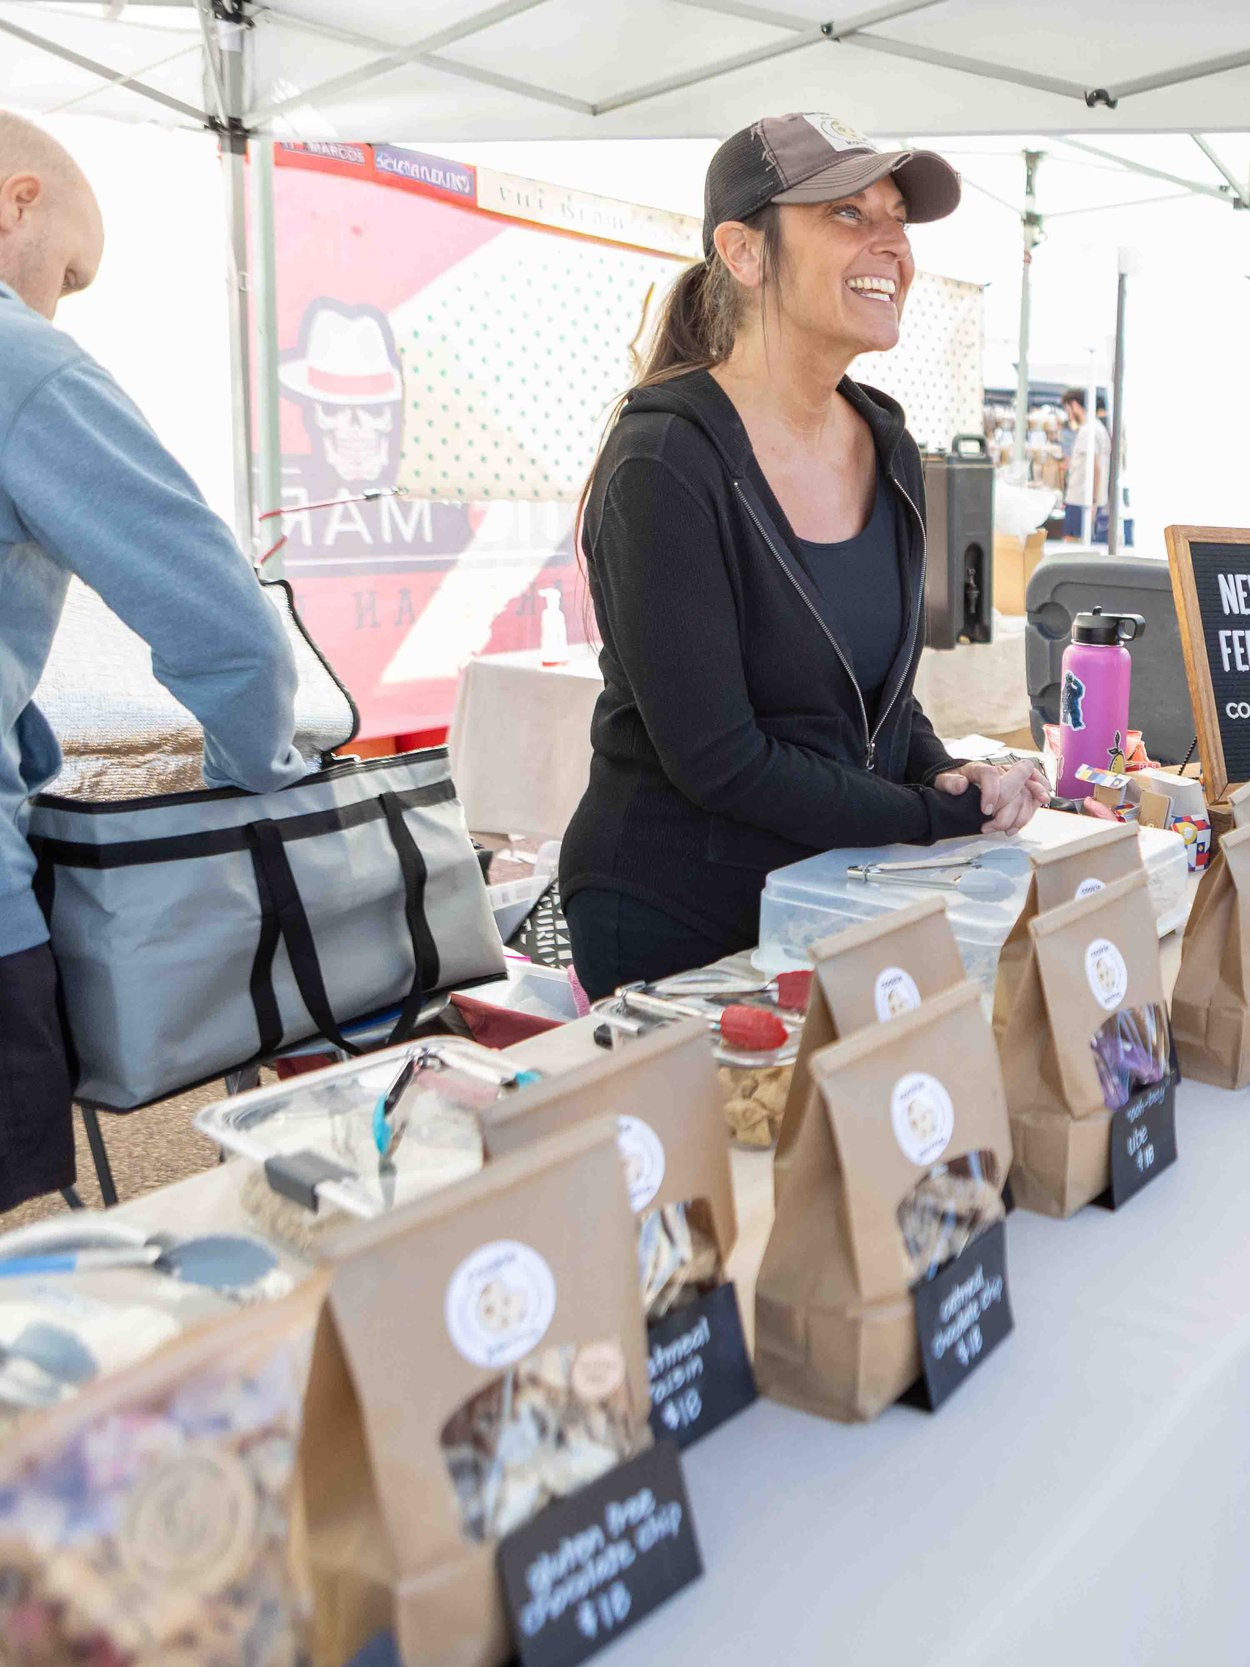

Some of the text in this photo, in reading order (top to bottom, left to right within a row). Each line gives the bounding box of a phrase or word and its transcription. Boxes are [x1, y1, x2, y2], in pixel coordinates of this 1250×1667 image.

[1126, 1123, 1149, 1157] ube
[1135, 1142, 1155, 1173] $18
[956, 1322, 983, 1368] $18
[661, 1386, 703, 1431] $18
[525, 1486, 656, 1602] gluten free
[634, 1501, 684, 1553] chip
[575, 1580, 632, 1641] $18
